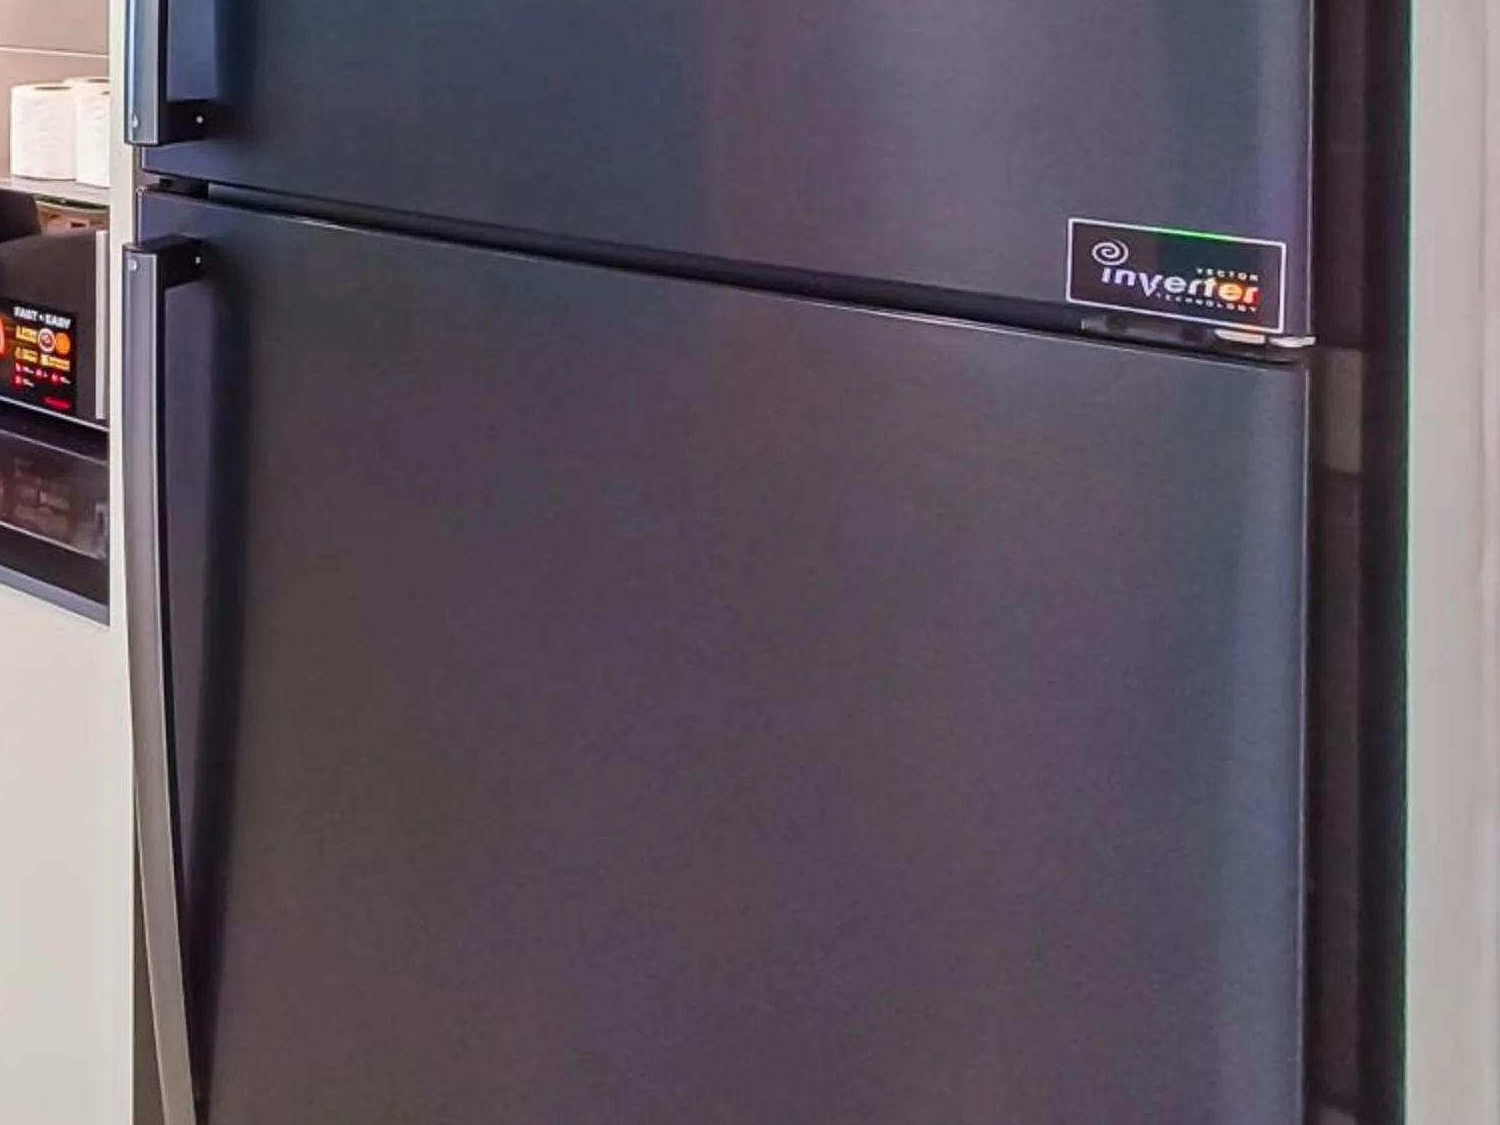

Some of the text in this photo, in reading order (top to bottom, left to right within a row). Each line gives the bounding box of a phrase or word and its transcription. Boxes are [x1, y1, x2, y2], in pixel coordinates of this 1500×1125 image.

[1195, 266, 1258, 281] VECTOR
[1101, 266, 1260, 305] inverter
[1155, 291, 1257, 312] TECHNOLOGY
